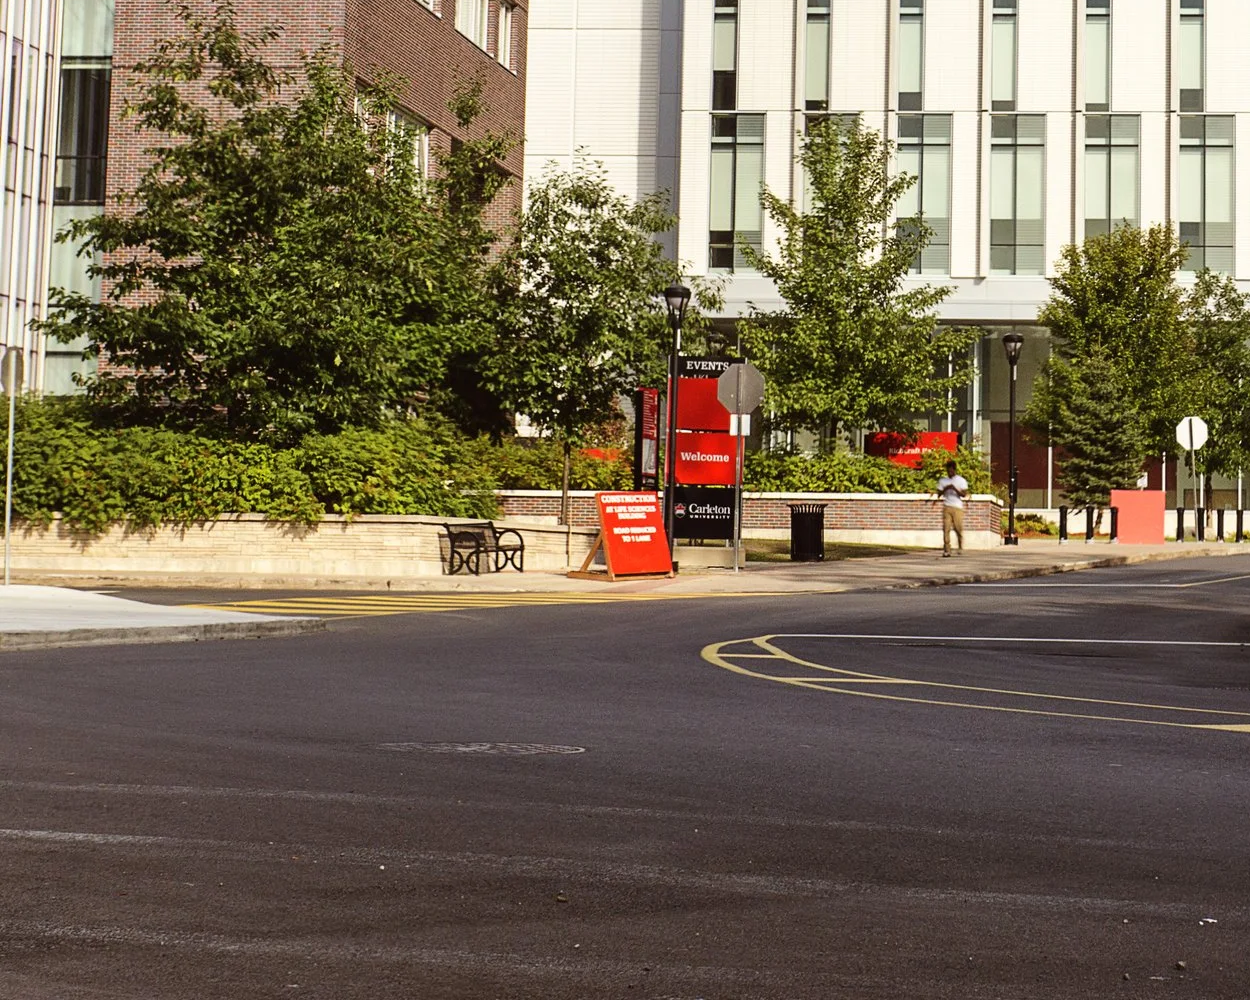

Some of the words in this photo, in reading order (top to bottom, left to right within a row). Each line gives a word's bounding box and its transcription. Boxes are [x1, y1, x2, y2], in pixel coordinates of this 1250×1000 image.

[686, 361, 729, 370] EVENTS
[681, 452, 730, 462] Welcome
[689, 503, 730, 514] Carleton
